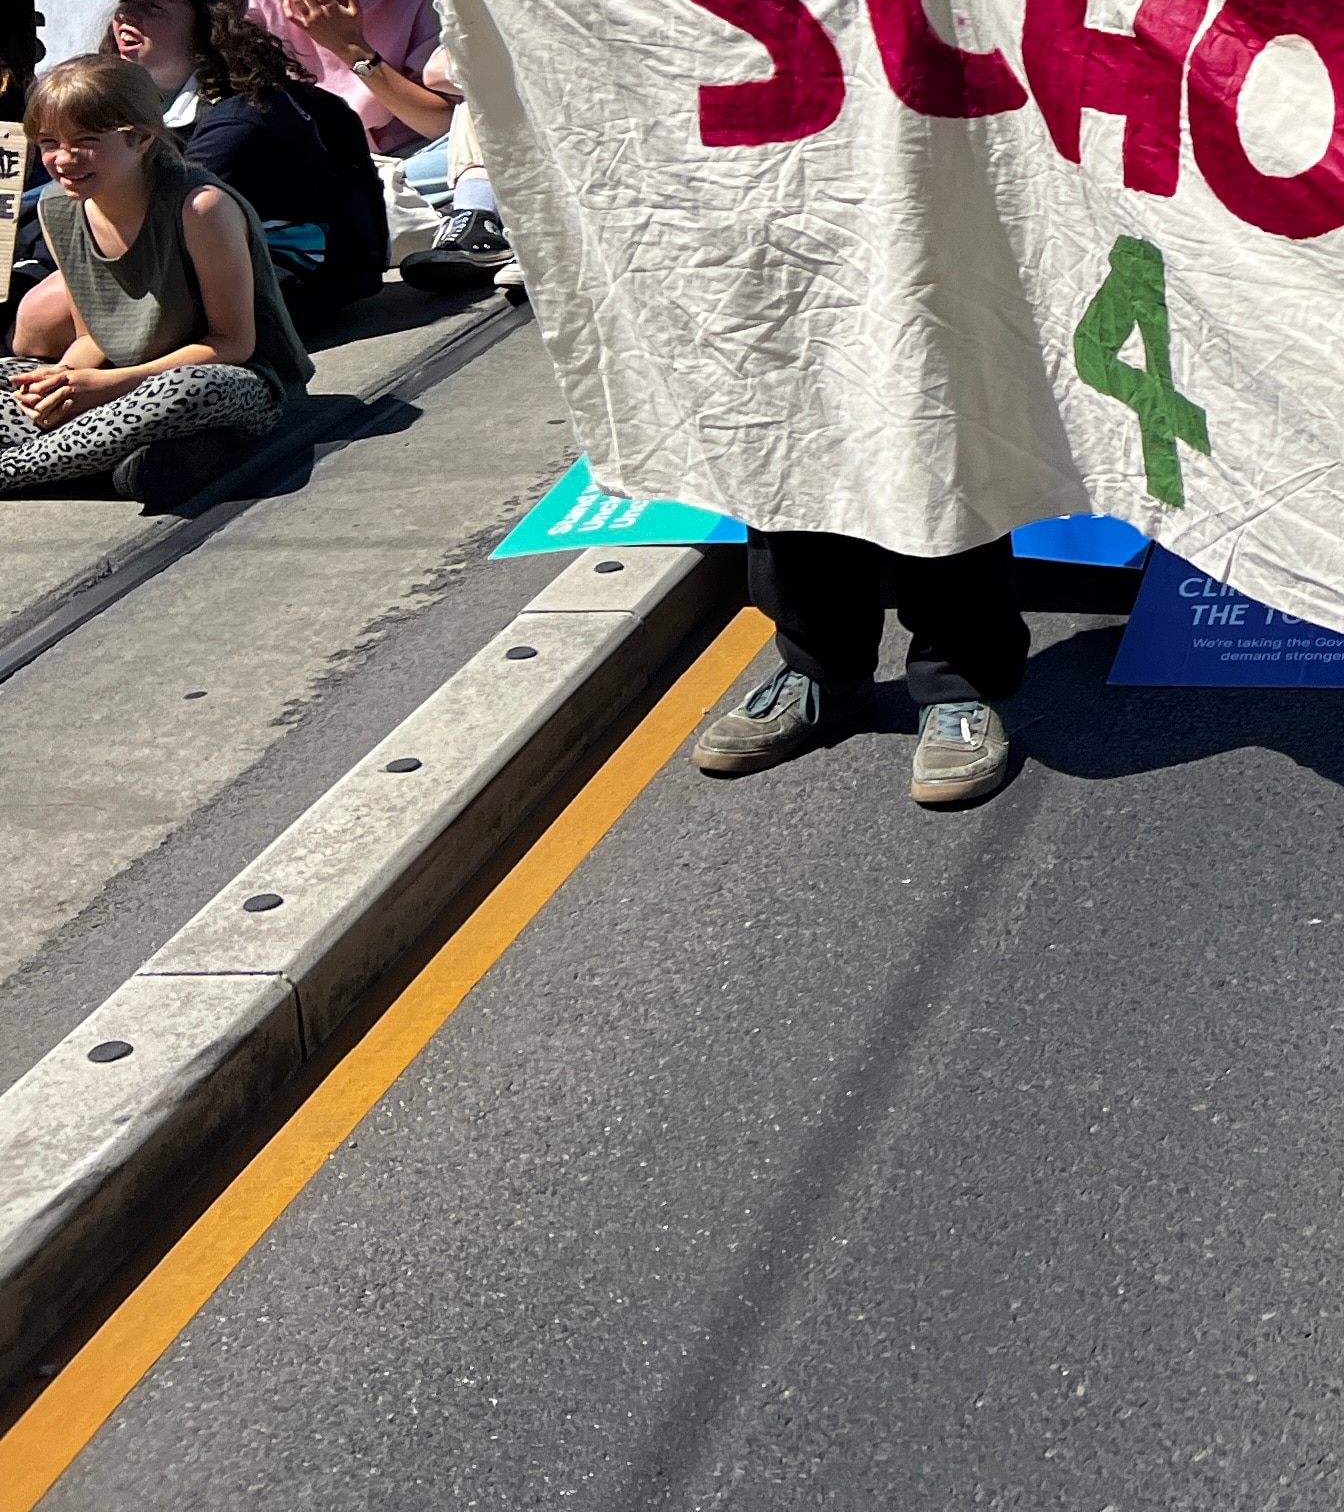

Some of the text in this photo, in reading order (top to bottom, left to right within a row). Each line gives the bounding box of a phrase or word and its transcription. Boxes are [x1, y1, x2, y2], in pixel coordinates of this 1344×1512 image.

[1074, 236, 1209, 507] 4
[1191, 604, 1249, 626] THE
[1193, 638, 1232, 648] We're
[1237, 637, 1282, 650] taking
[1286, 637, 1311, 648] the
[1220, 651, 1281, 661] demand
